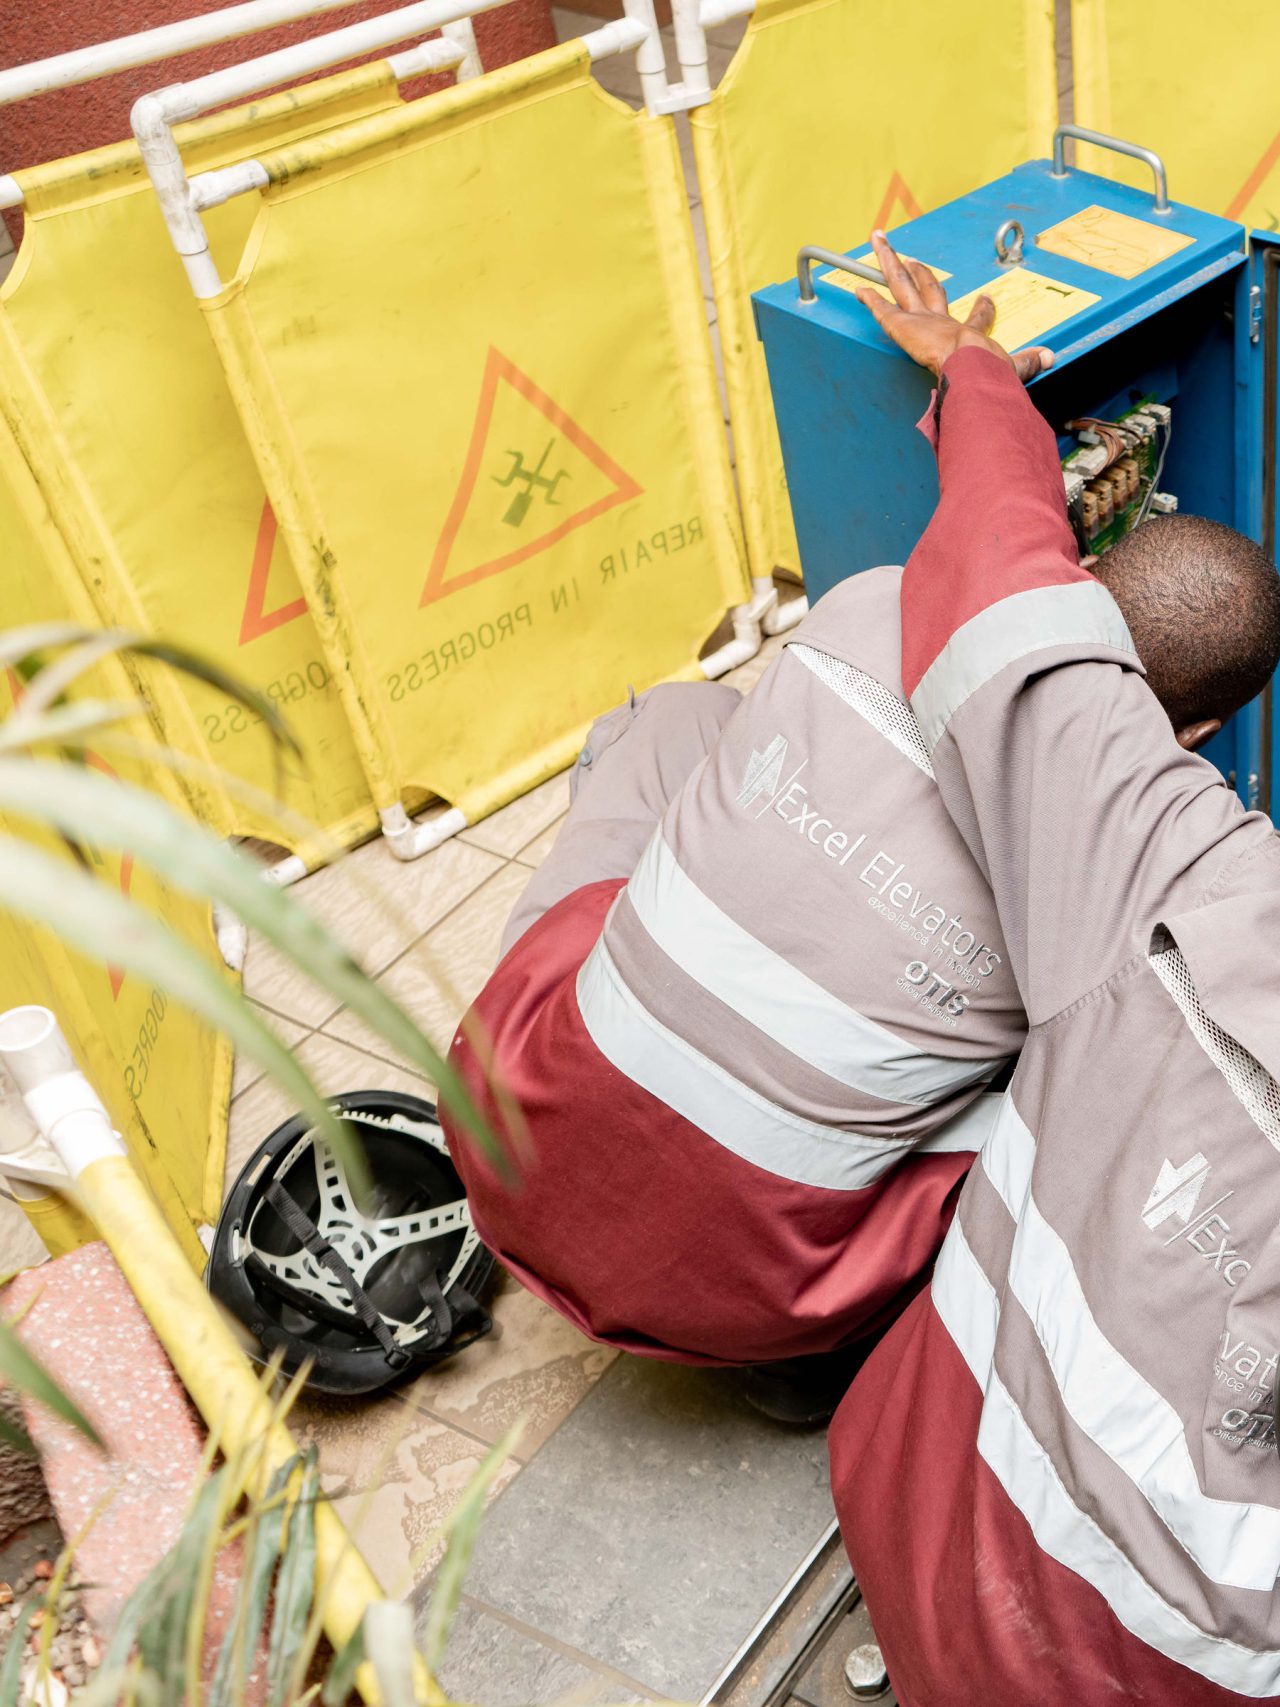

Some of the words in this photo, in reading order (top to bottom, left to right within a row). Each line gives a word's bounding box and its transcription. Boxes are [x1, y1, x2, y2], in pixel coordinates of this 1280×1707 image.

[773, 782, 867, 865] Excel
[859, 851, 1002, 977] Elevators
[868, 896, 929, 946] excellence
[904, 960, 970, 1016] OTIS
[1186, 1213, 1251, 1287] Exc
